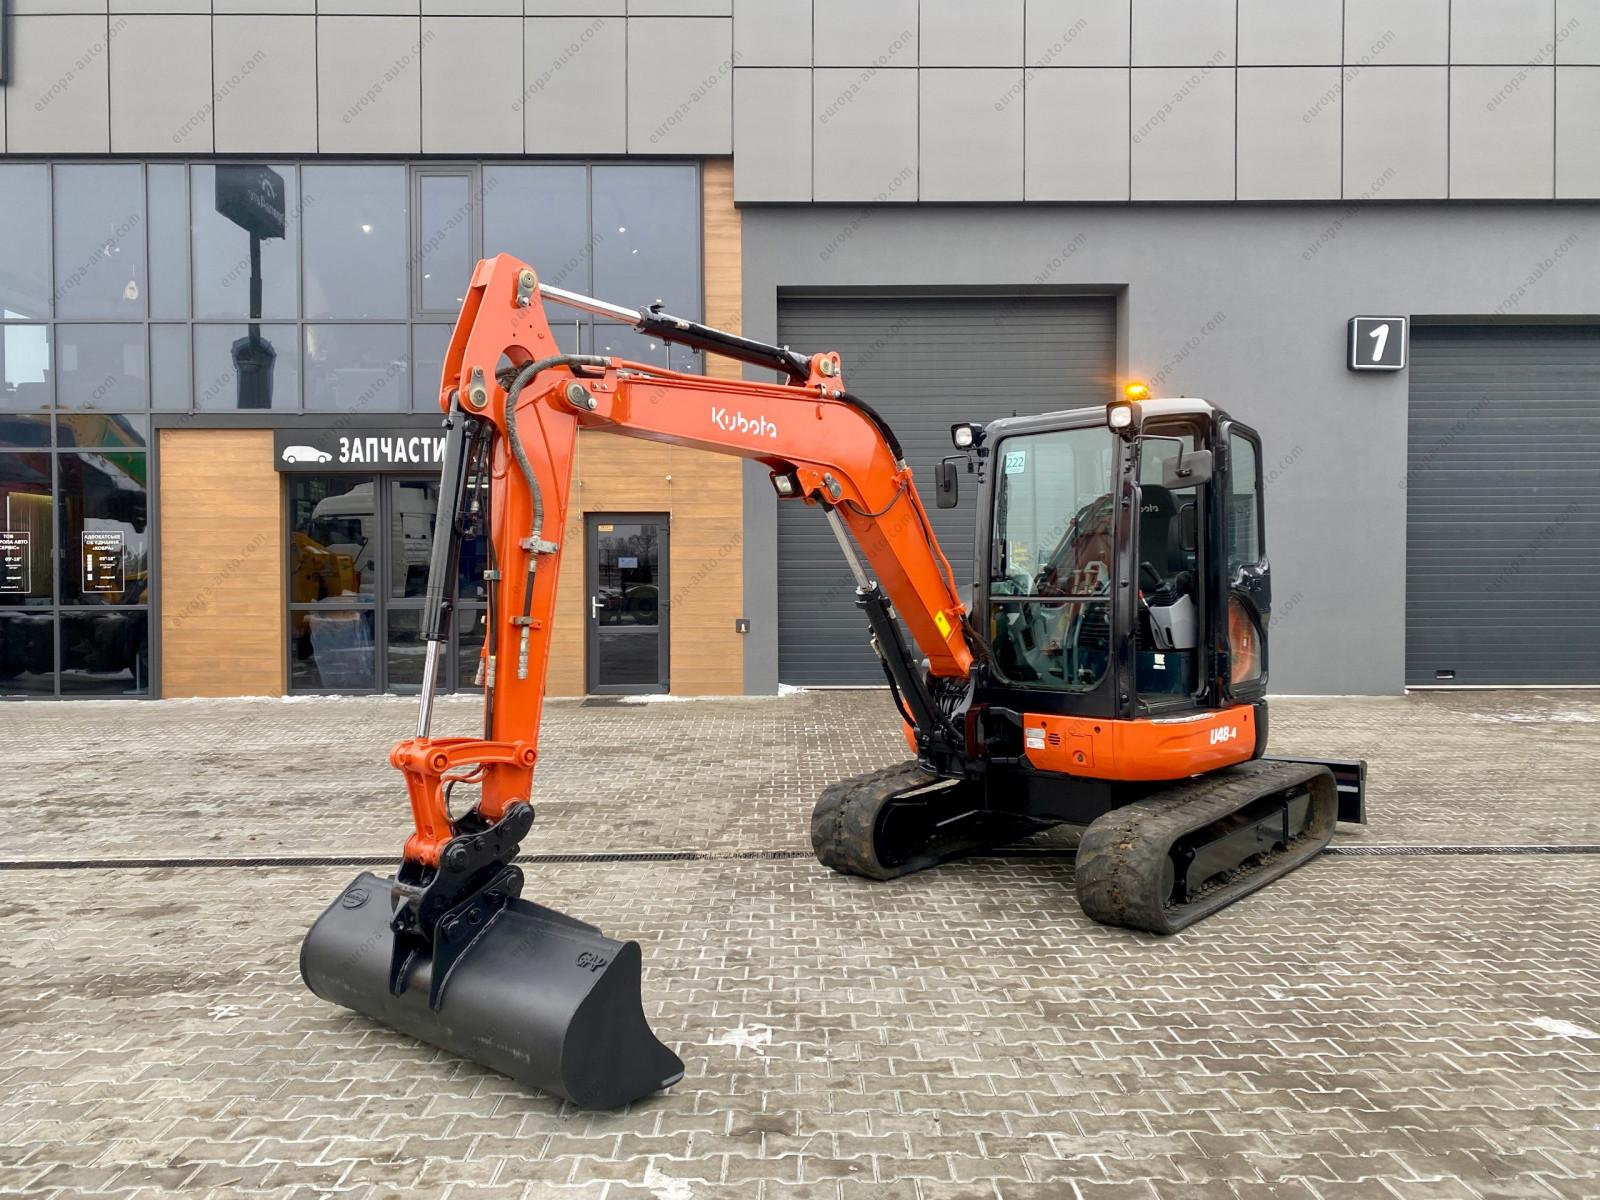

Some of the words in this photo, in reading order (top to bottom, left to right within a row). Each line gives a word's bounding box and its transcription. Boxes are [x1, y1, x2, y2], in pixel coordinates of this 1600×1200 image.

[1369, 324, 1390, 362] 1
[711, 406, 777, 439] Kubota
[339, 436, 446, 464] ЗАПЧАСТИ
[1006, 456, 1024, 468] 222
[1210, 726, 1237, 745] U48-4
